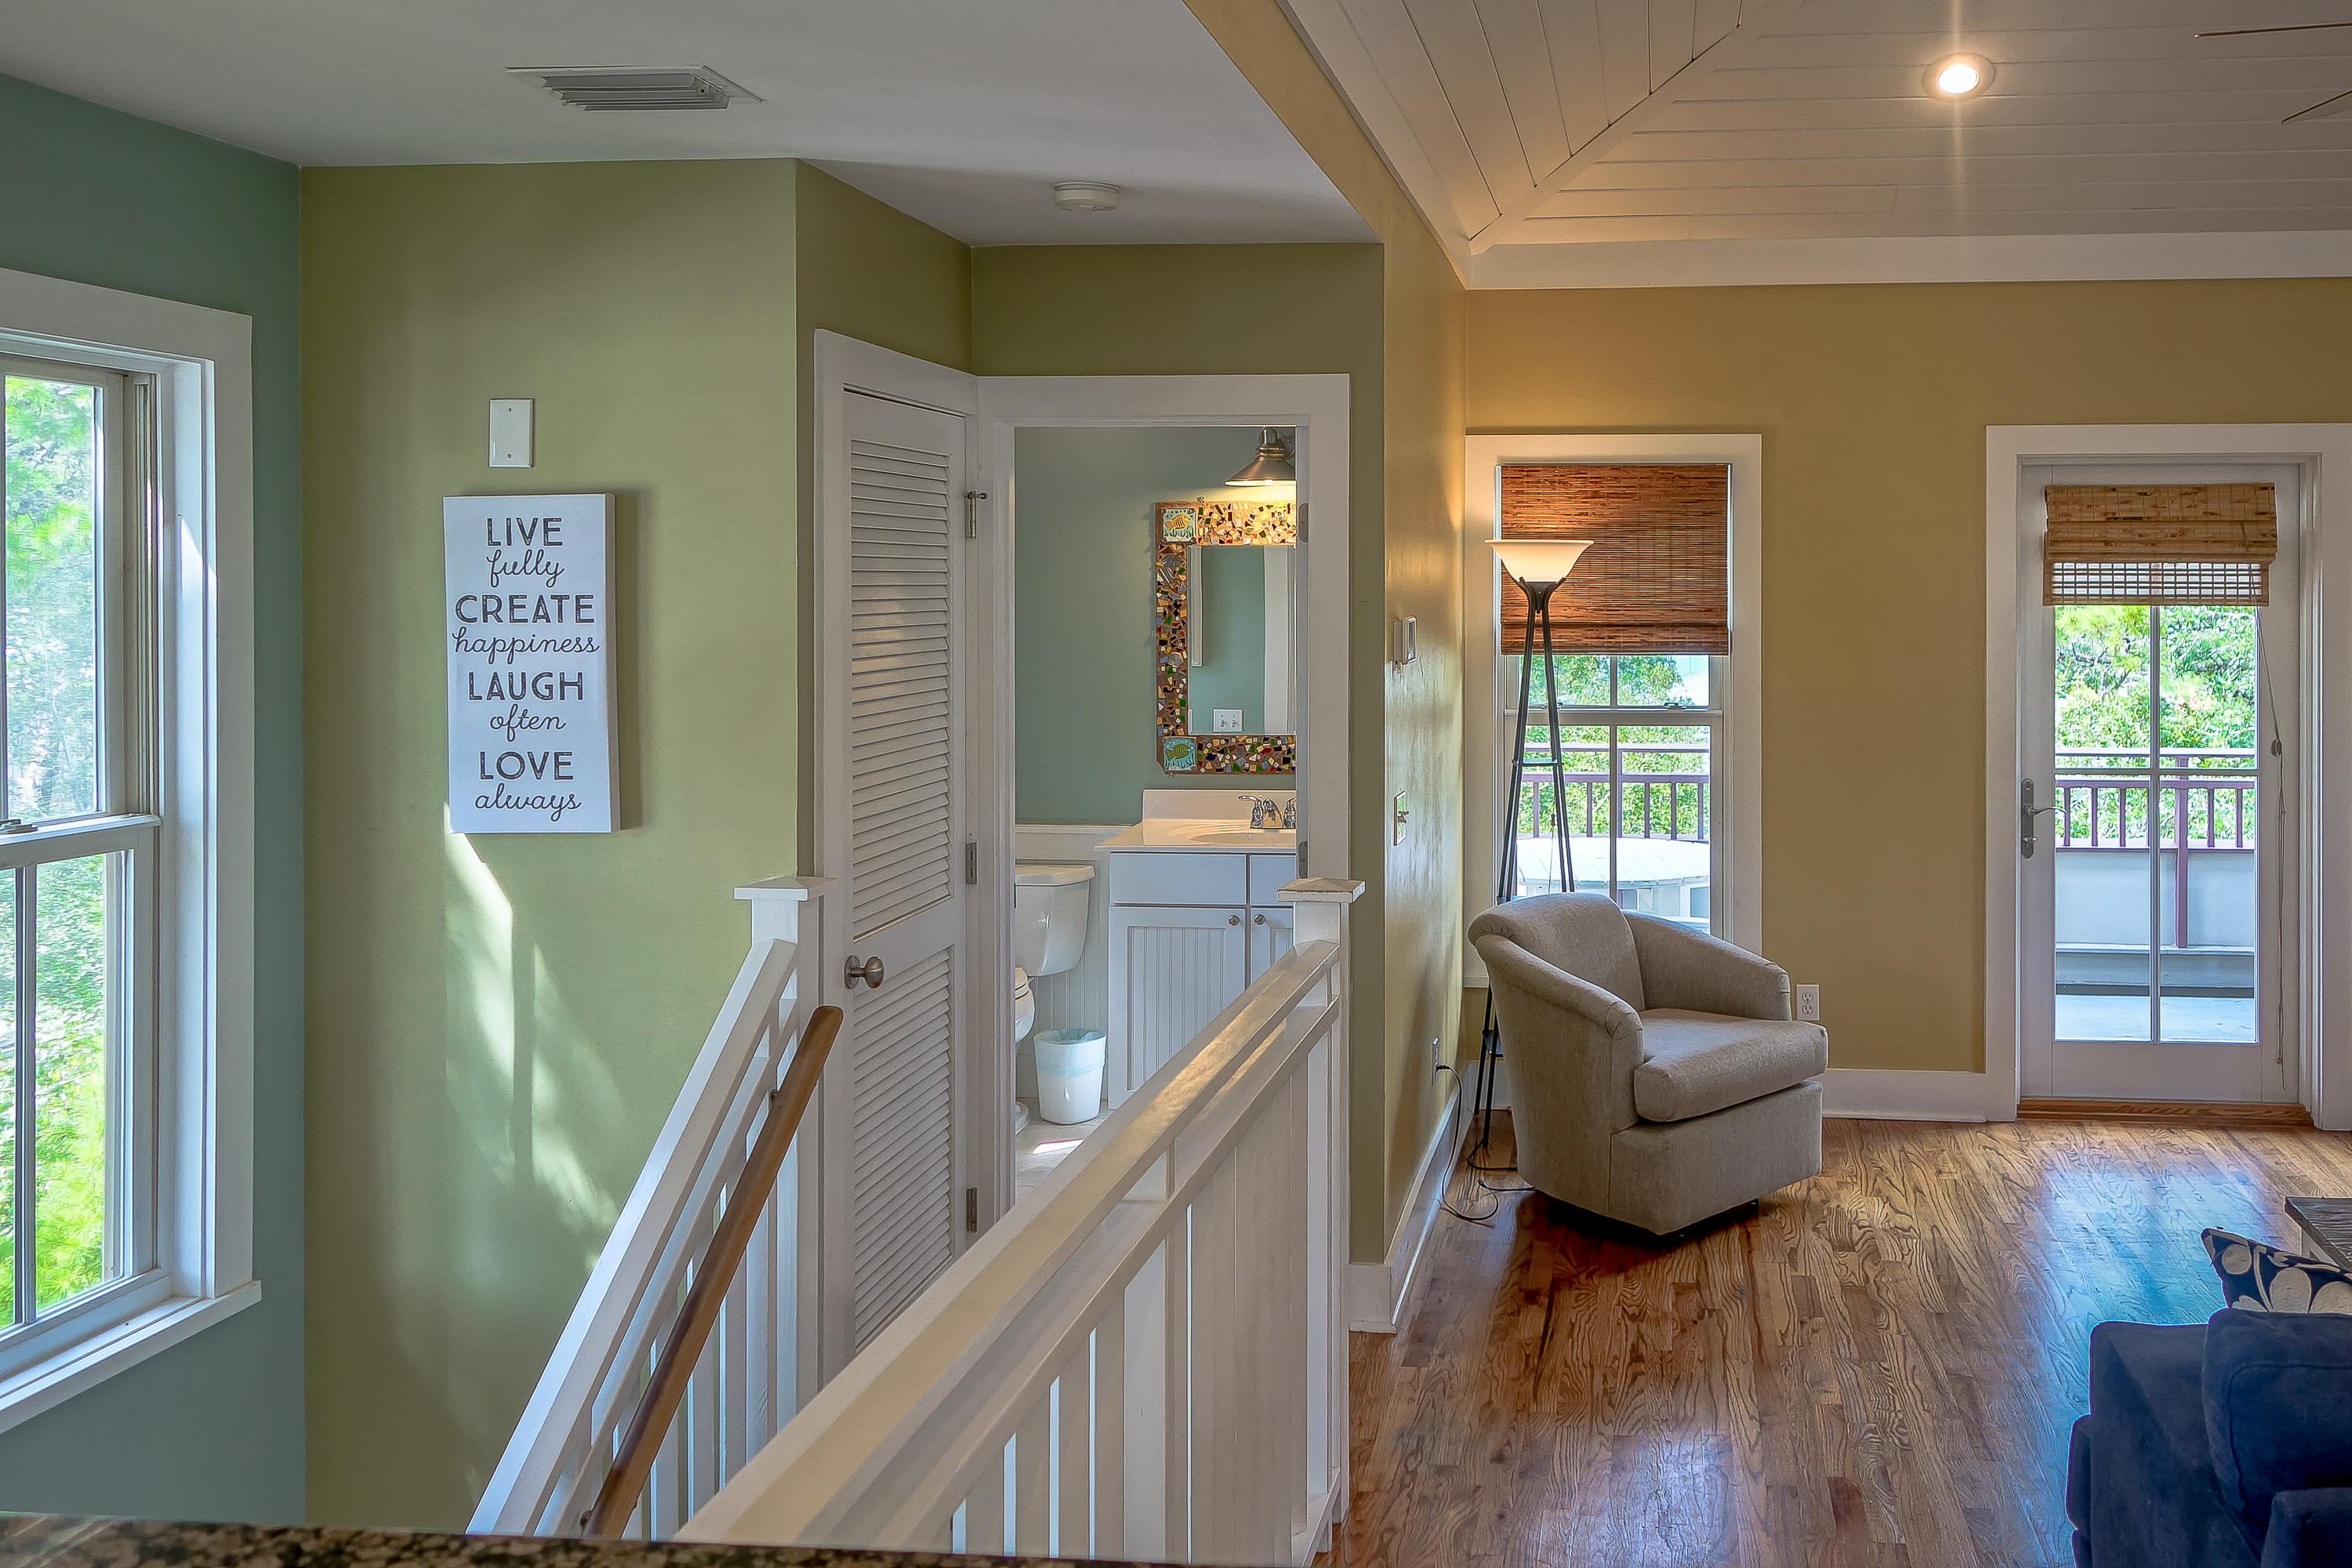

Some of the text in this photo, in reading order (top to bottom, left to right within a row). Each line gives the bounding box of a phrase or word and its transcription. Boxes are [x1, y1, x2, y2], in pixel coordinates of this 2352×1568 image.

[486, 517, 564, 546] LIVE
[485, 549, 565, 588] fully
[455, 594, 595, 623] CREATE
[452, 626, 601, 665] happiness
[468, 672, 583, 701] LAUGH
[489, 703, 567, 742] often
[479, 751, 574, 781] LOVE
[474, 782, 583, 822] always
